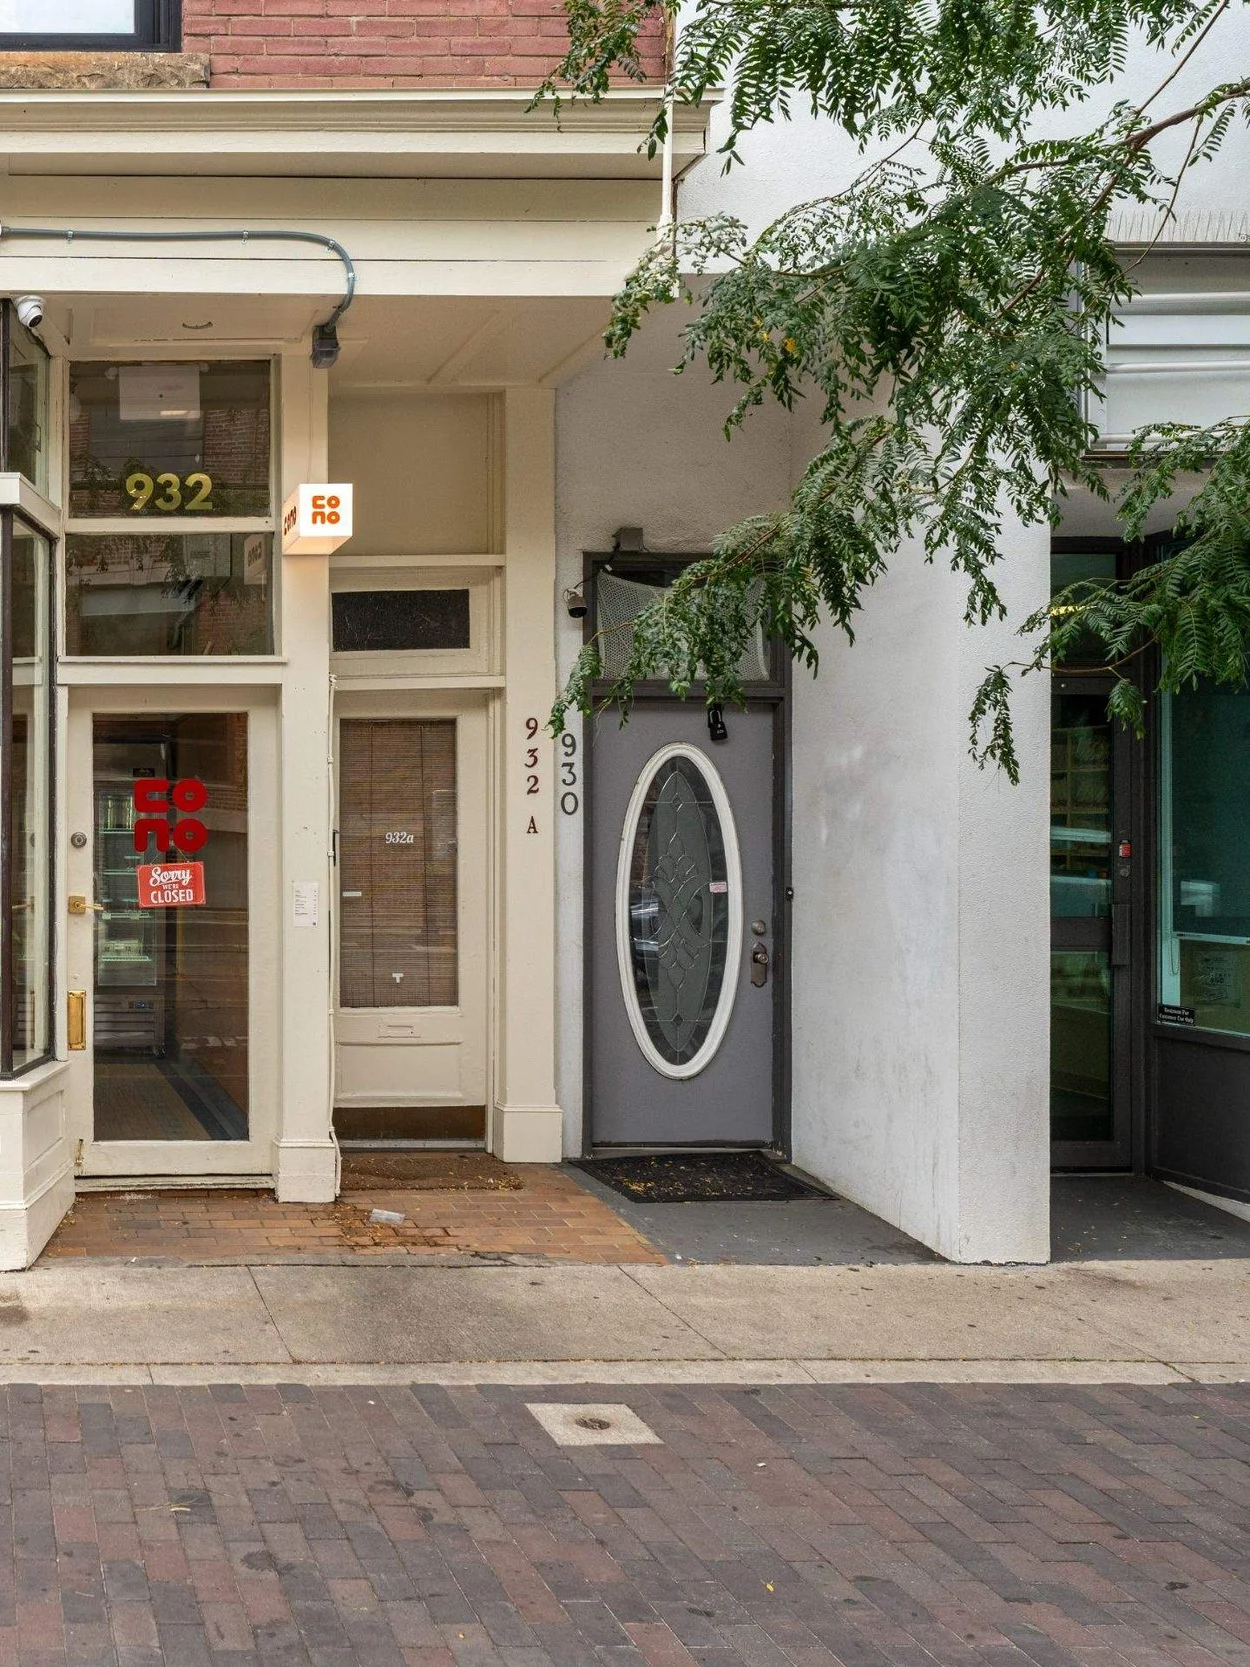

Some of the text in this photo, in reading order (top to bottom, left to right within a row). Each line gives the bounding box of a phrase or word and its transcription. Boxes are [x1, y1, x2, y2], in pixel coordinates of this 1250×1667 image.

[126, 473, 213, 511] 932
[312, 495, 341, 509] co
[312, 511, 341, 525] no
[560, 733, 579, 816] 930
[134, 778, 209, 813] co
[134, 818, 209, 853] no
[385, 831, 414, 844] 932a
[149, 867, 193, 887] Sorry
[150, 889, 194, 904] CLOSED
